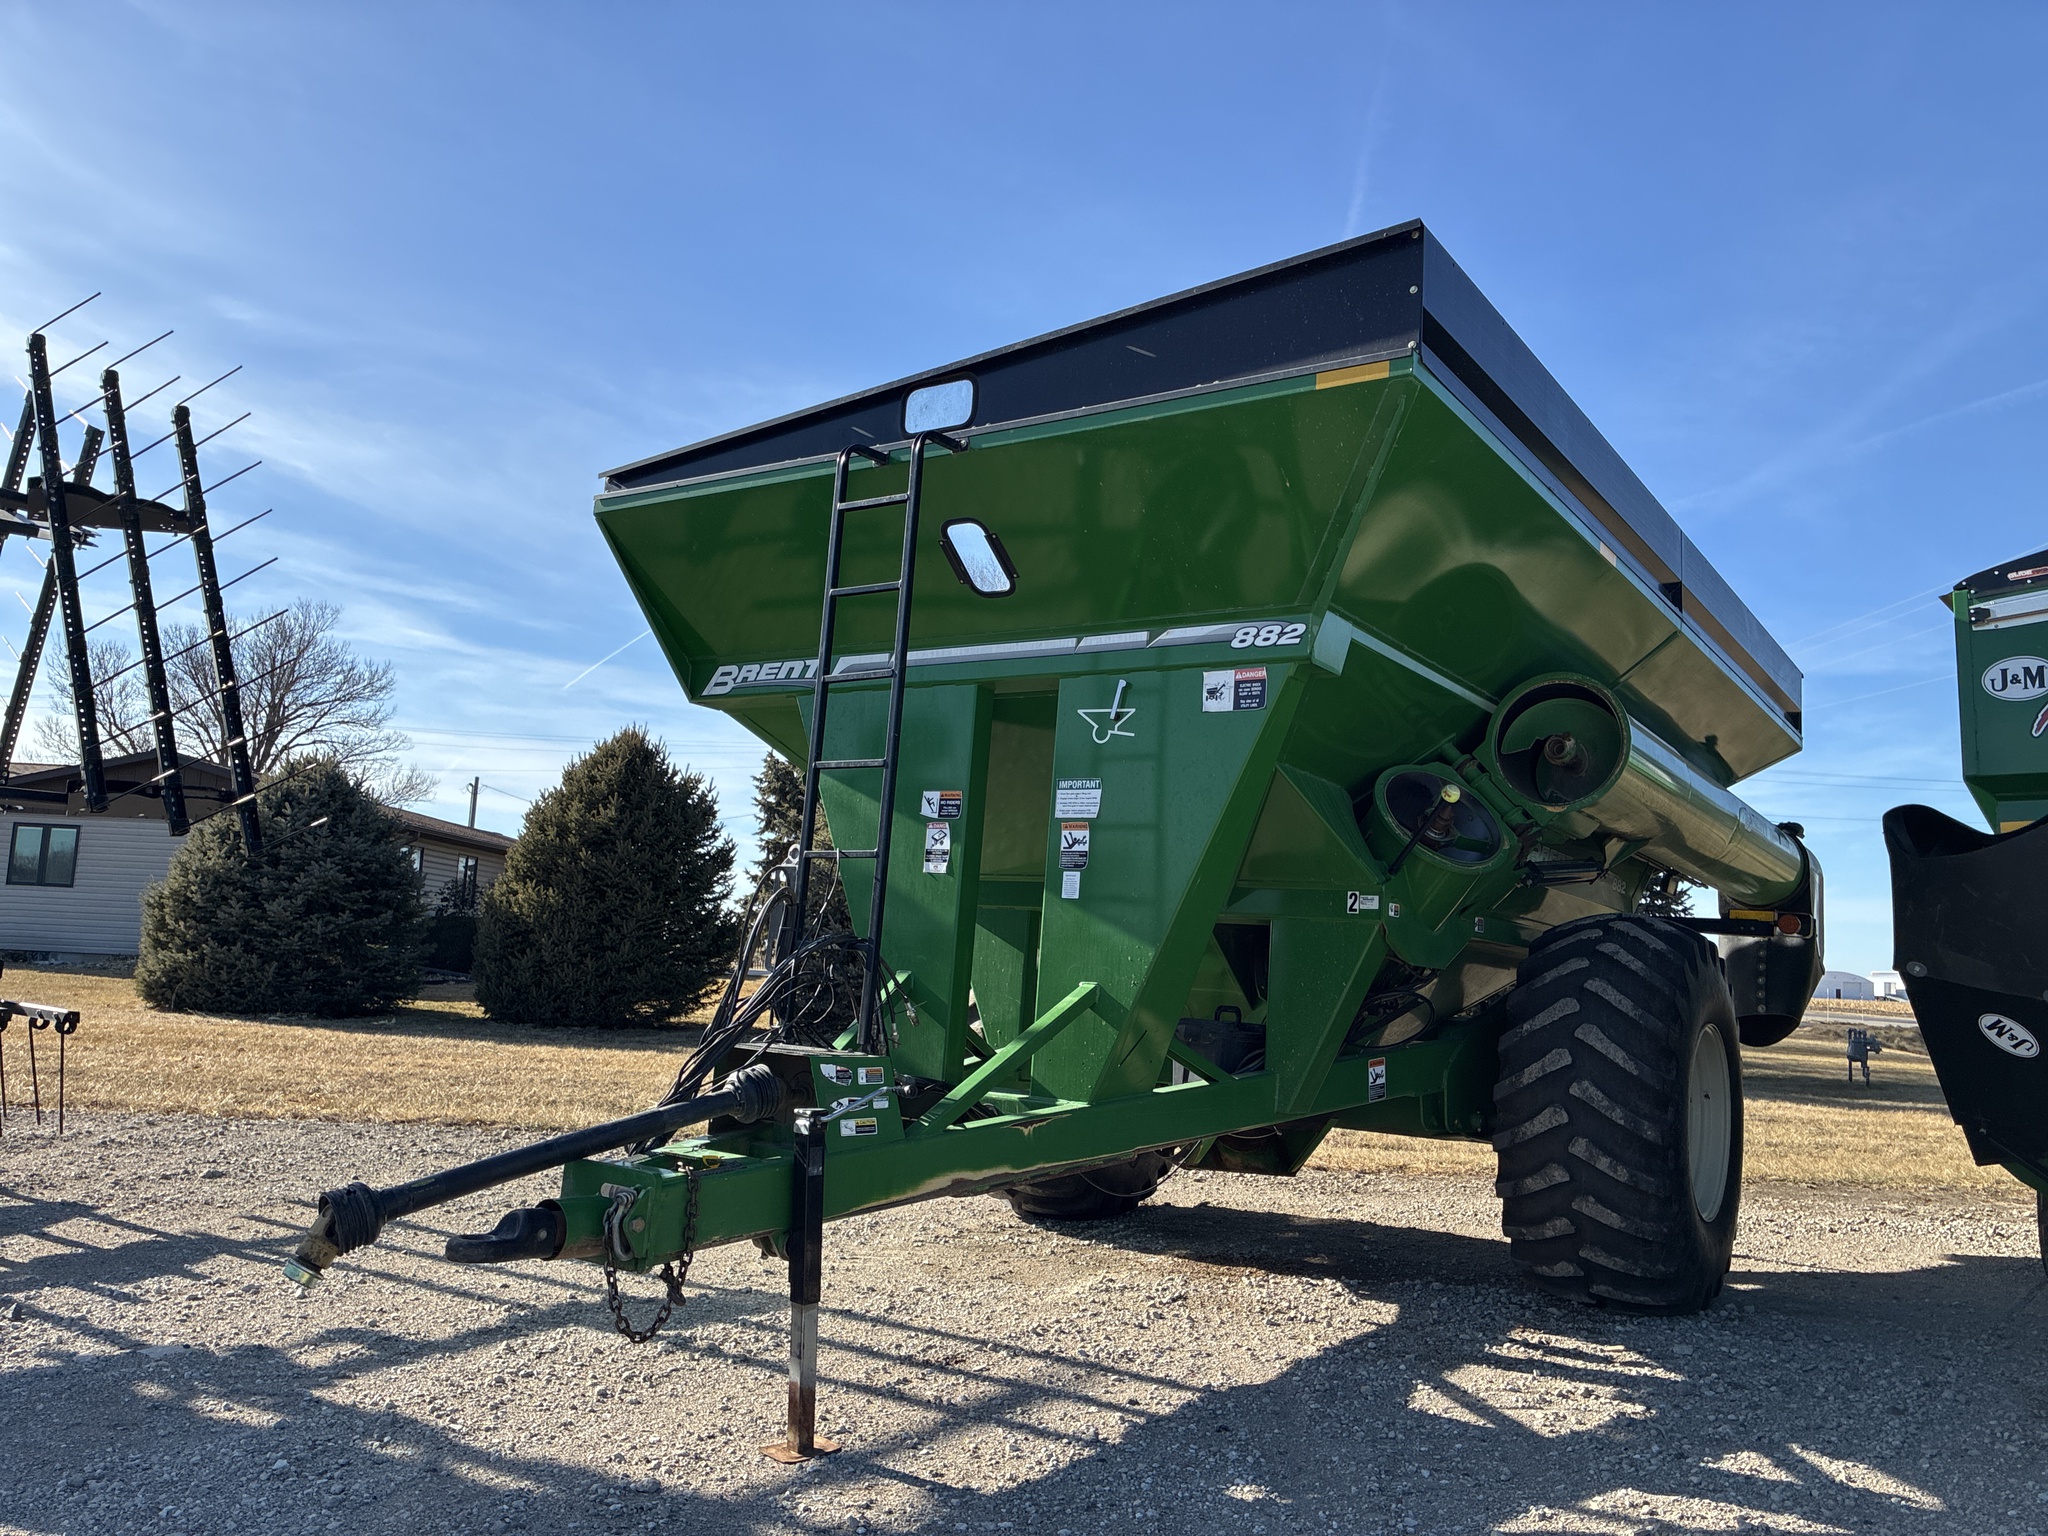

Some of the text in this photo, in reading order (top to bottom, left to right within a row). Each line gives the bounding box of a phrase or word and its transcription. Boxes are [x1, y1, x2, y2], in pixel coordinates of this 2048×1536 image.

[1230, 623, 1307, 649] 882
[701, 660, 819, 696] BRENT
[1989, 665, 2046, 692] J&M
[1058, 780, 1100, 789] IMPORTANT
[1349, 892, 1358, 912] 2
[1984, 1018, 2035, 1052] J&M
